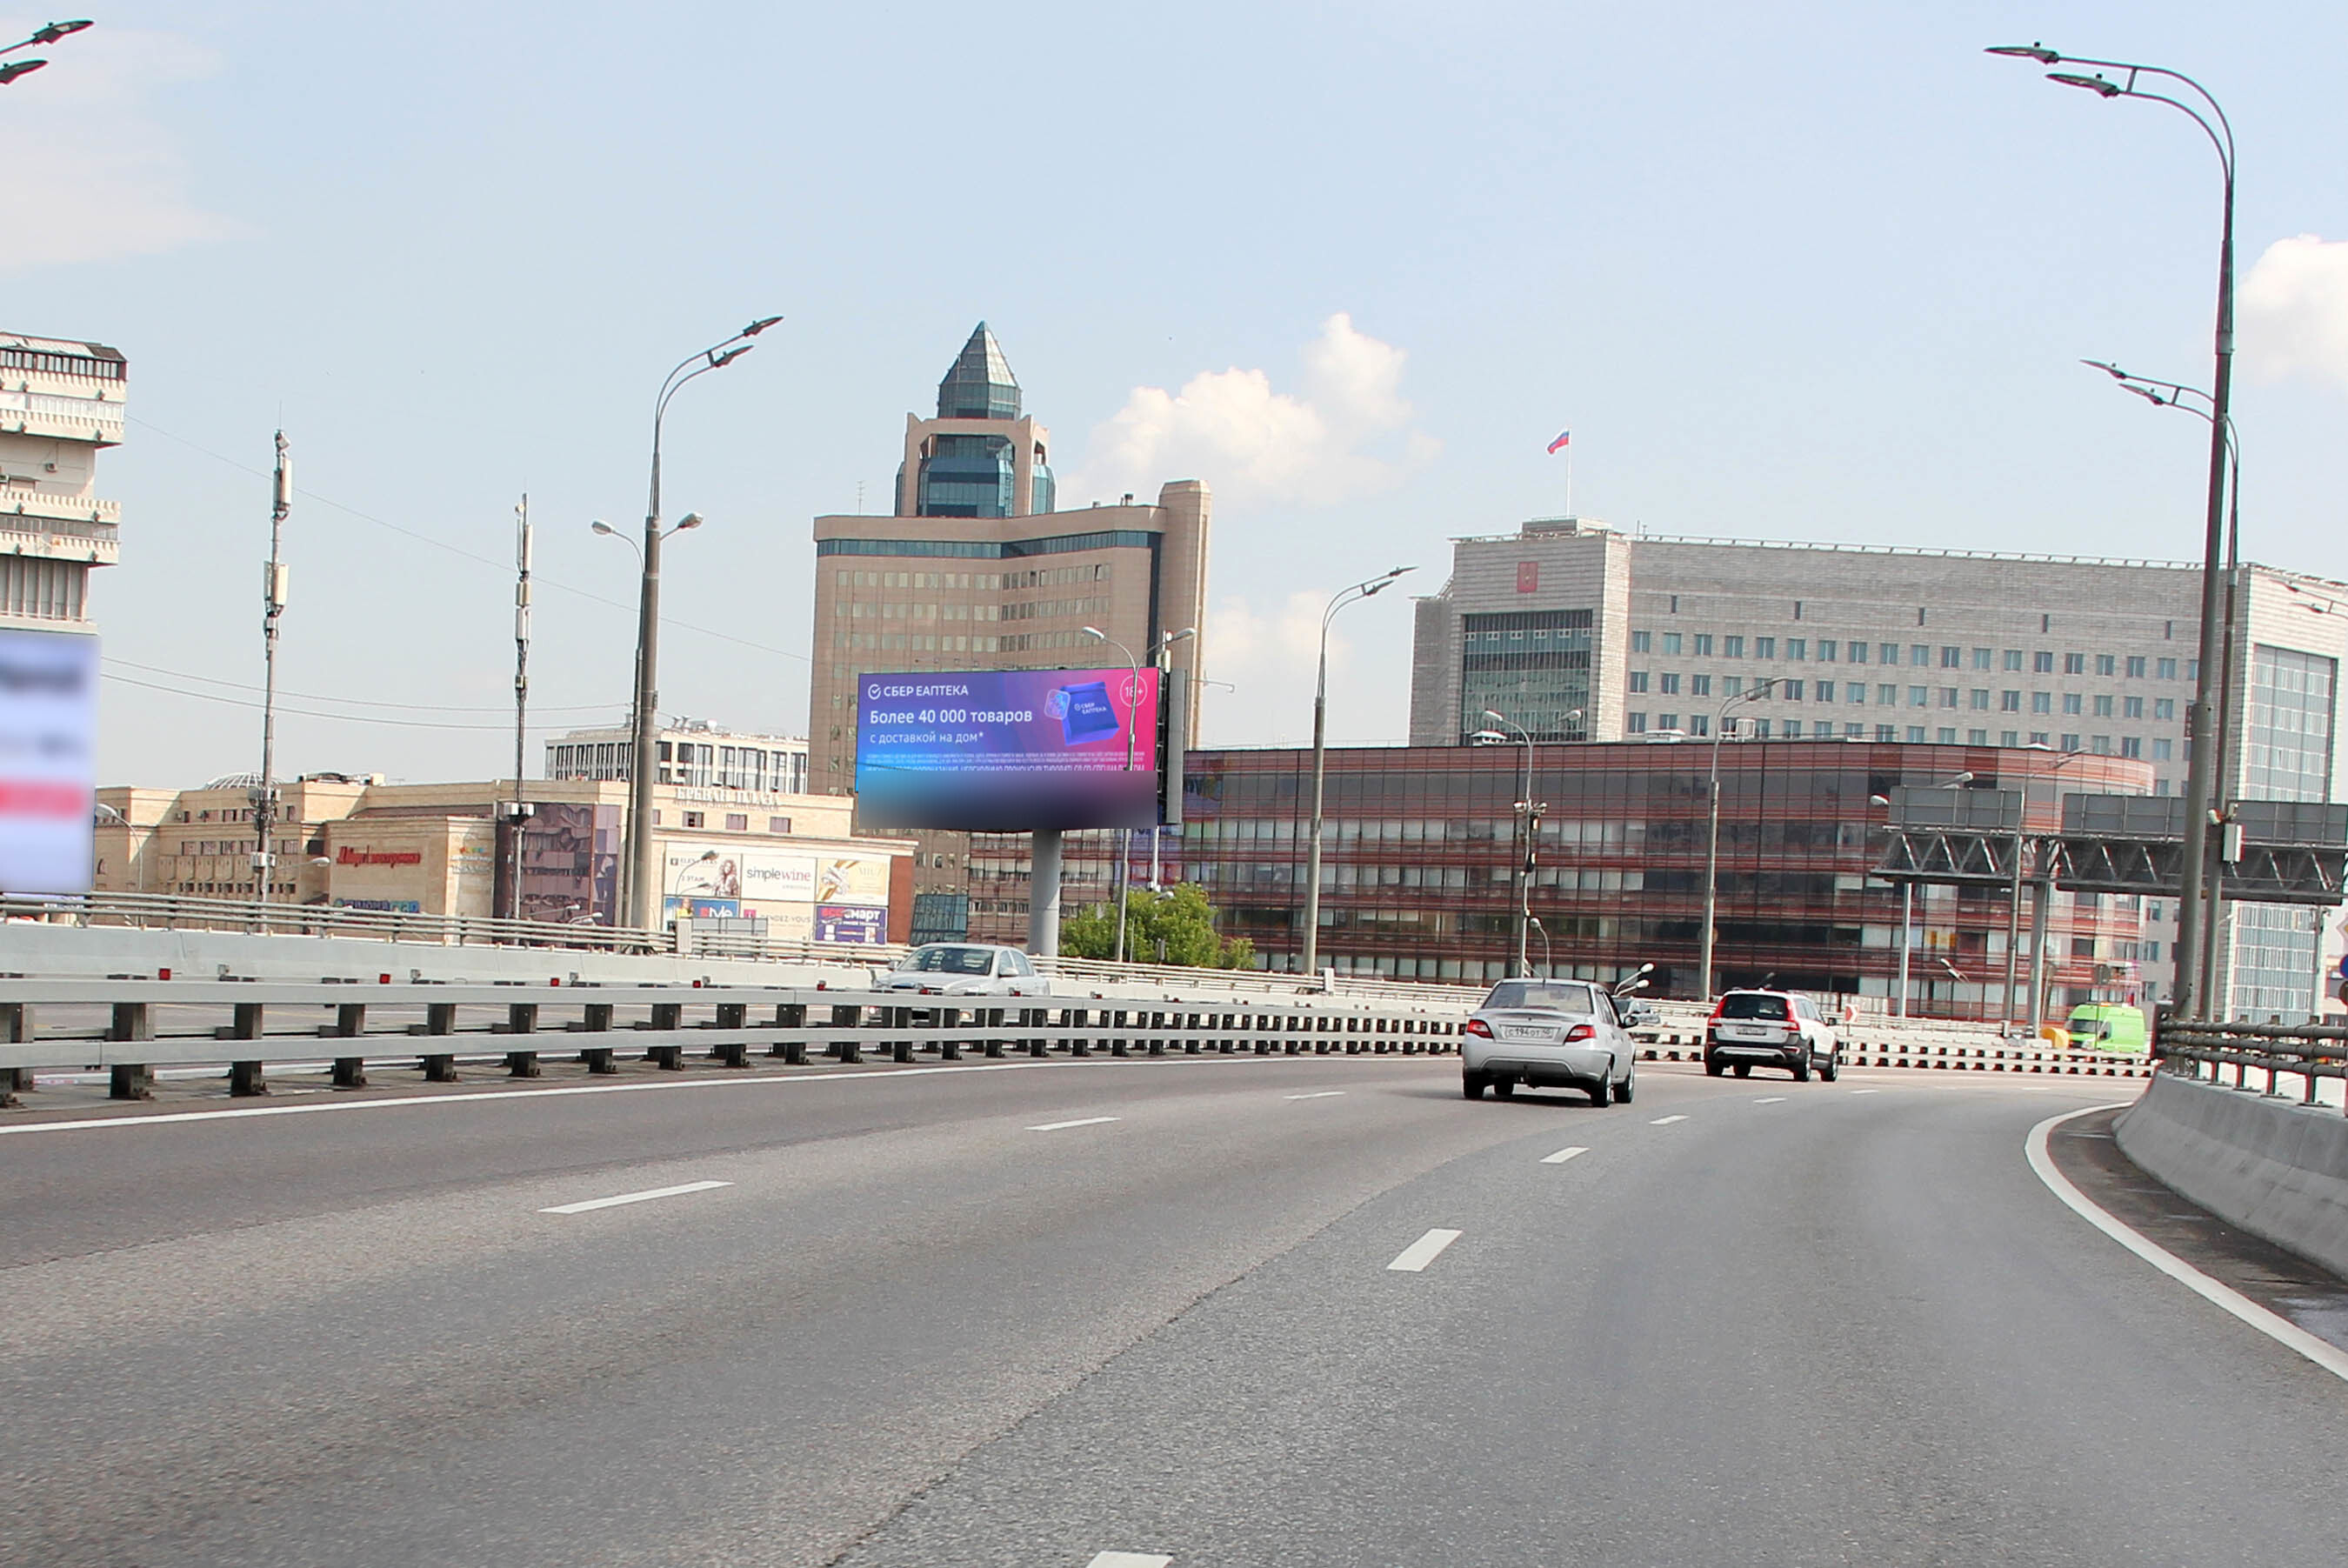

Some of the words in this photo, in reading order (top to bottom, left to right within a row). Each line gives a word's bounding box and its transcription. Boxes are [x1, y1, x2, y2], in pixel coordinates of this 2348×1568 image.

[884, 685, 914, 697] СБЕР
[917, 684, 969, 696] ЕАПТЕКА
[870, 710, 915, 724] Более
[918, 710, 936, 724] 40
[940, 709, 966, 723] 000
[971, 710, 1032, 725] товаров
[870, 733, 877, 744] с
[879, 731, 936, 744] доставкой
[939, 732, 952, 743] на
